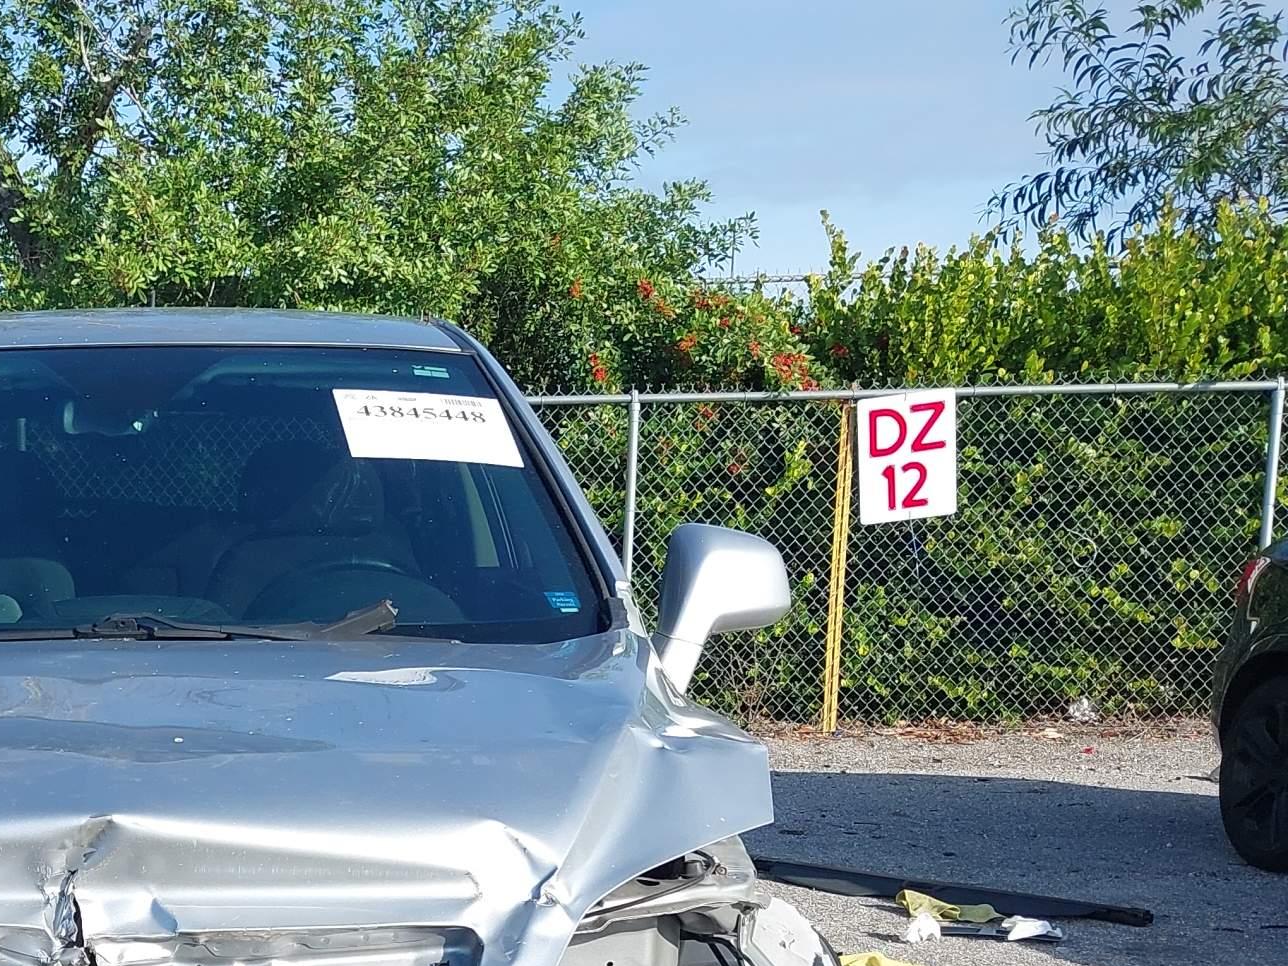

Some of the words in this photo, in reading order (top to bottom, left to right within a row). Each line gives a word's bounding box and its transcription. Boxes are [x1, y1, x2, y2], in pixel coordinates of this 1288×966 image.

[357, 404, 486, 423] 43845448
[869, 401, 946, 457] DZ
[881, 462, 928, 510] 12
